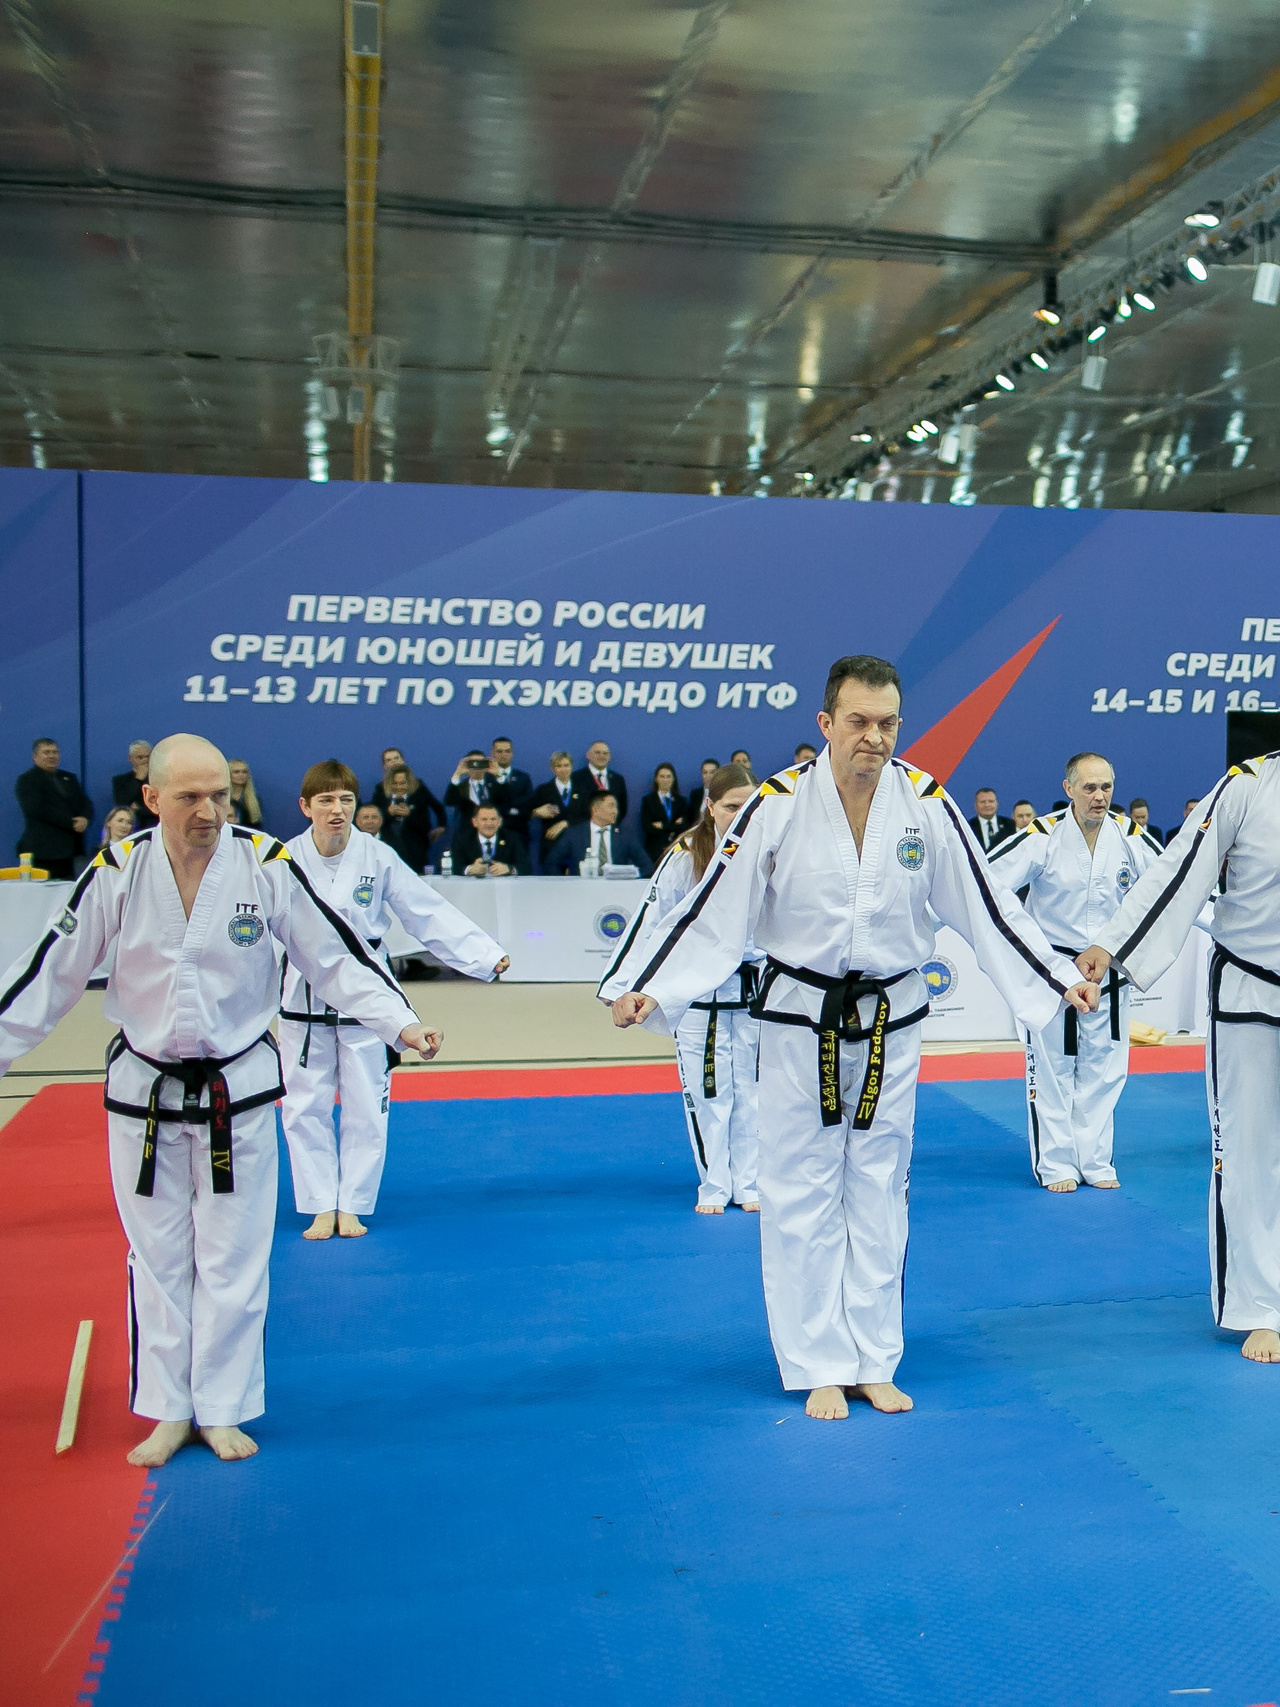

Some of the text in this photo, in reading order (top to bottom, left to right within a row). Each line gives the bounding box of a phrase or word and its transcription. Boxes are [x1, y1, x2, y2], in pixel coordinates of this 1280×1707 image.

[286, 594, 707, 631] ПЕРВЕНСТВО РОССИИ
[210, 632, 776, 673] СРЕДИ ЮНОШЕЙ И ДЕВУШЕК
[1166, 652, 1276, 683] СРЕДИ
[306, 677, 388, 706] ЛЕТ
[396, 677, 455, 706] ПО
[466, 678, 707, 714] ТХЭКВОНДО
[716, 681, 798, 710] ИТФ
[1191, 689, 1216, 714] И
[905, 827, 920, 835] ITF
[360, 876, 376, 884] ITF
[236, 903, 259, 914] ITF
[863, 1001, 888, 1101] Igor Fedotov
[858, 1101, 876, 1119] IV
[212, 1149, 231, 1172] IV
